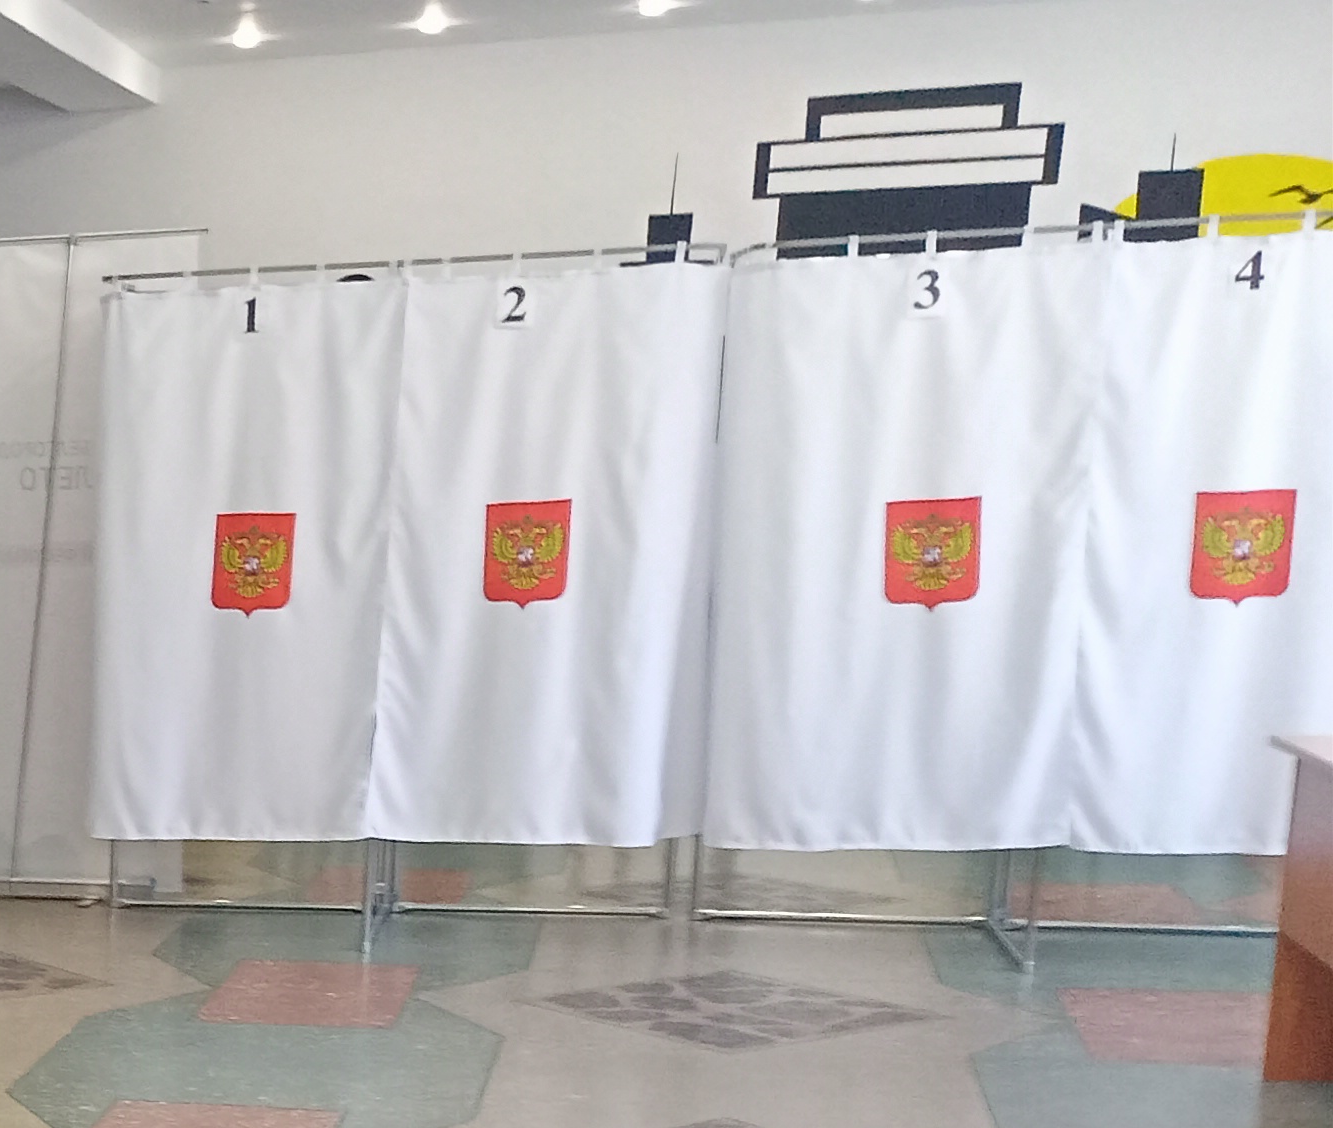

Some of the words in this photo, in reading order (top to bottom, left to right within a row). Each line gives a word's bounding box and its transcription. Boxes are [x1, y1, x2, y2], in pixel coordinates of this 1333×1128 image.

[913, 269, 940, 309] 3
[1235, 250, 1264, 290] 4
[244, 296, 259, 334] 1
[501, 286, 526, 323] 2
